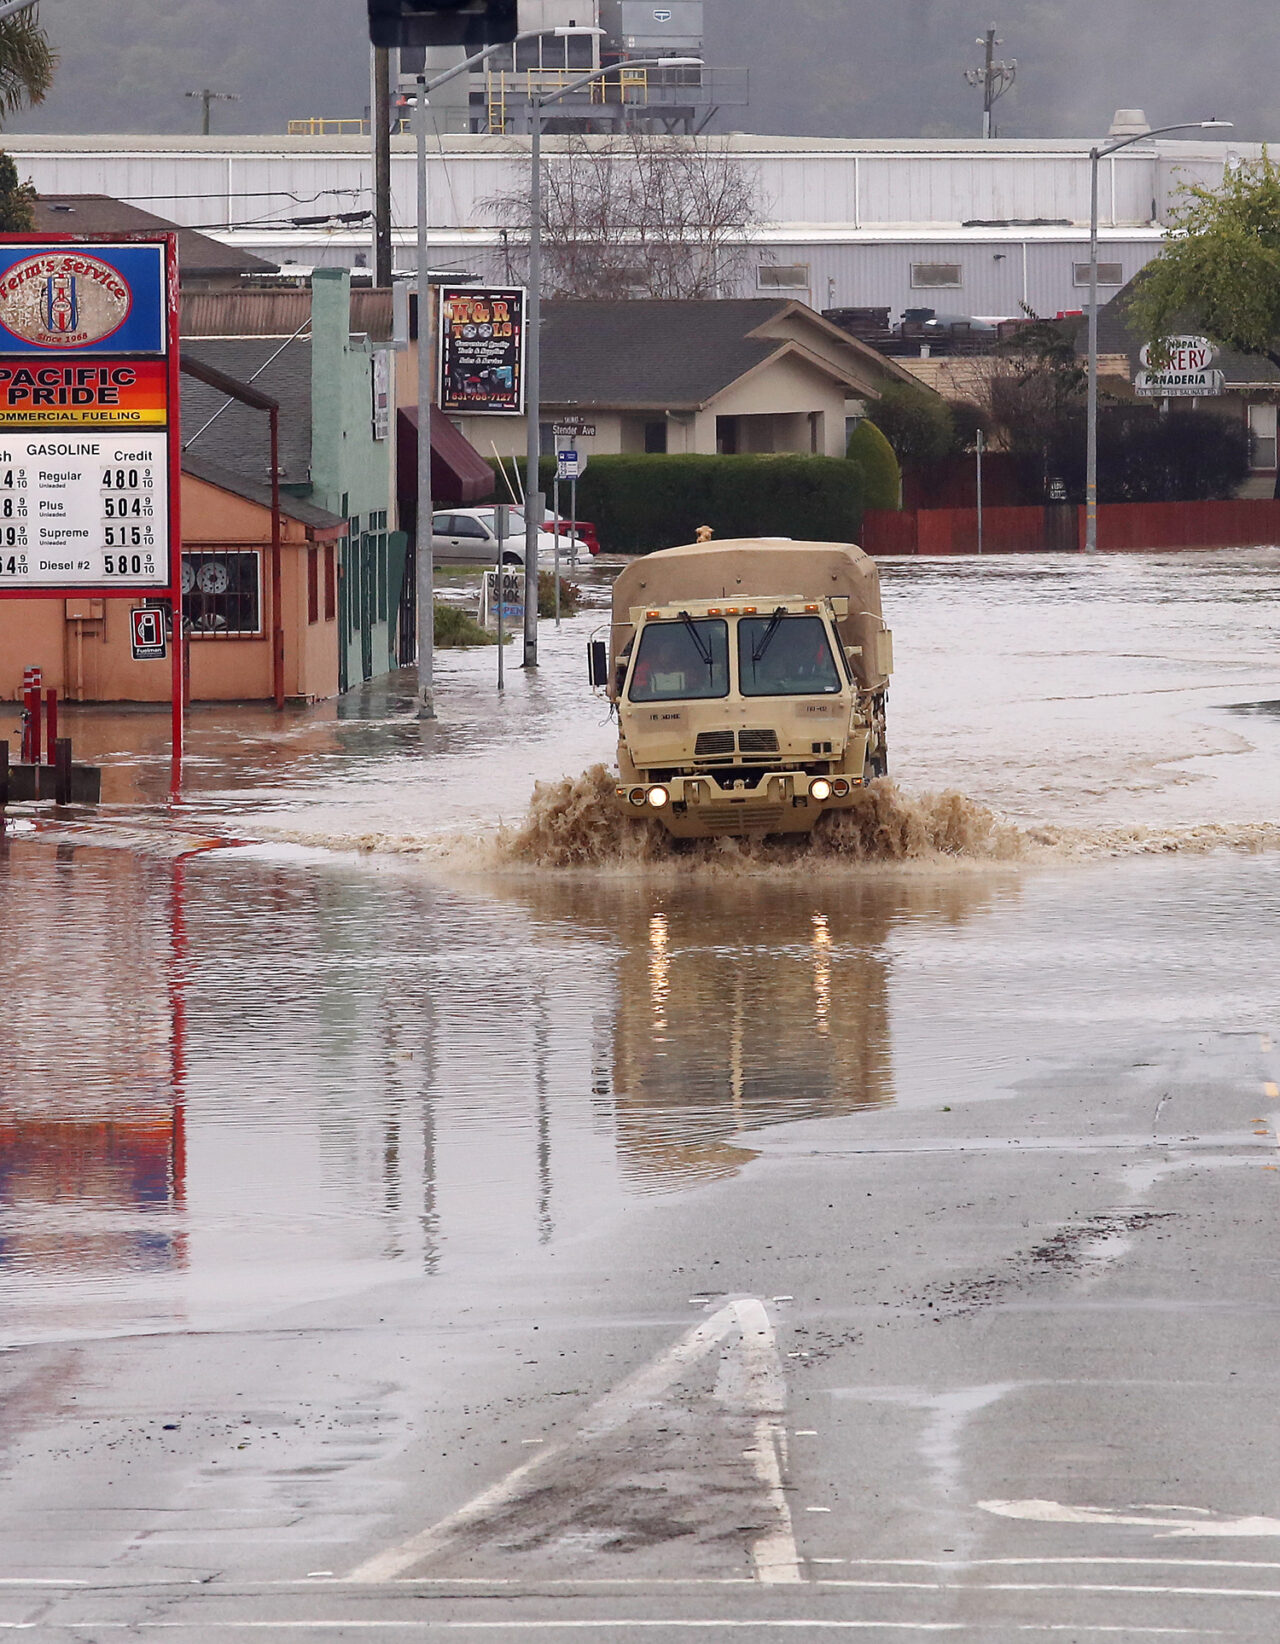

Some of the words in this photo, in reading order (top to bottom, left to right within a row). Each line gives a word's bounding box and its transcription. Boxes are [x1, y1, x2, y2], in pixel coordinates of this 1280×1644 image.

[61, 258, 126, 300] Service
[451, 303, 470, 323] H
[472, 302, 490, 323] &
[492, 302, 510, 322] R
[37, 333, 62, 343] Since
[65, 332, 88, 343] 1968
[1146, 349, 1206, 371] KERY
[7, 387, 120, 405] PRIDE
[82, 412, 141, 420] FUELING
[552, 425, 578, 435] Stender
[582, 426, 595, 435] Ave
[26, 444, 100, 456] GASOLINE
[114, 450, 153, 461] Credit
[38, 471, 82, 482] Regular
[103, 469, 138, 488] 480
[39, 501, 64, 510] Plus
[105, 498, 141, 516] 504
[0, 527, 15, 546] 9
[39, 528, 89, 539] Supreme
[105, 527, 141, 545] 515
[0, 556, 15, 574] 4
[39, 561, 74, 570] Diesel
[77, 561, 90, 570] #2
[104, 555, 141, 574] 580
